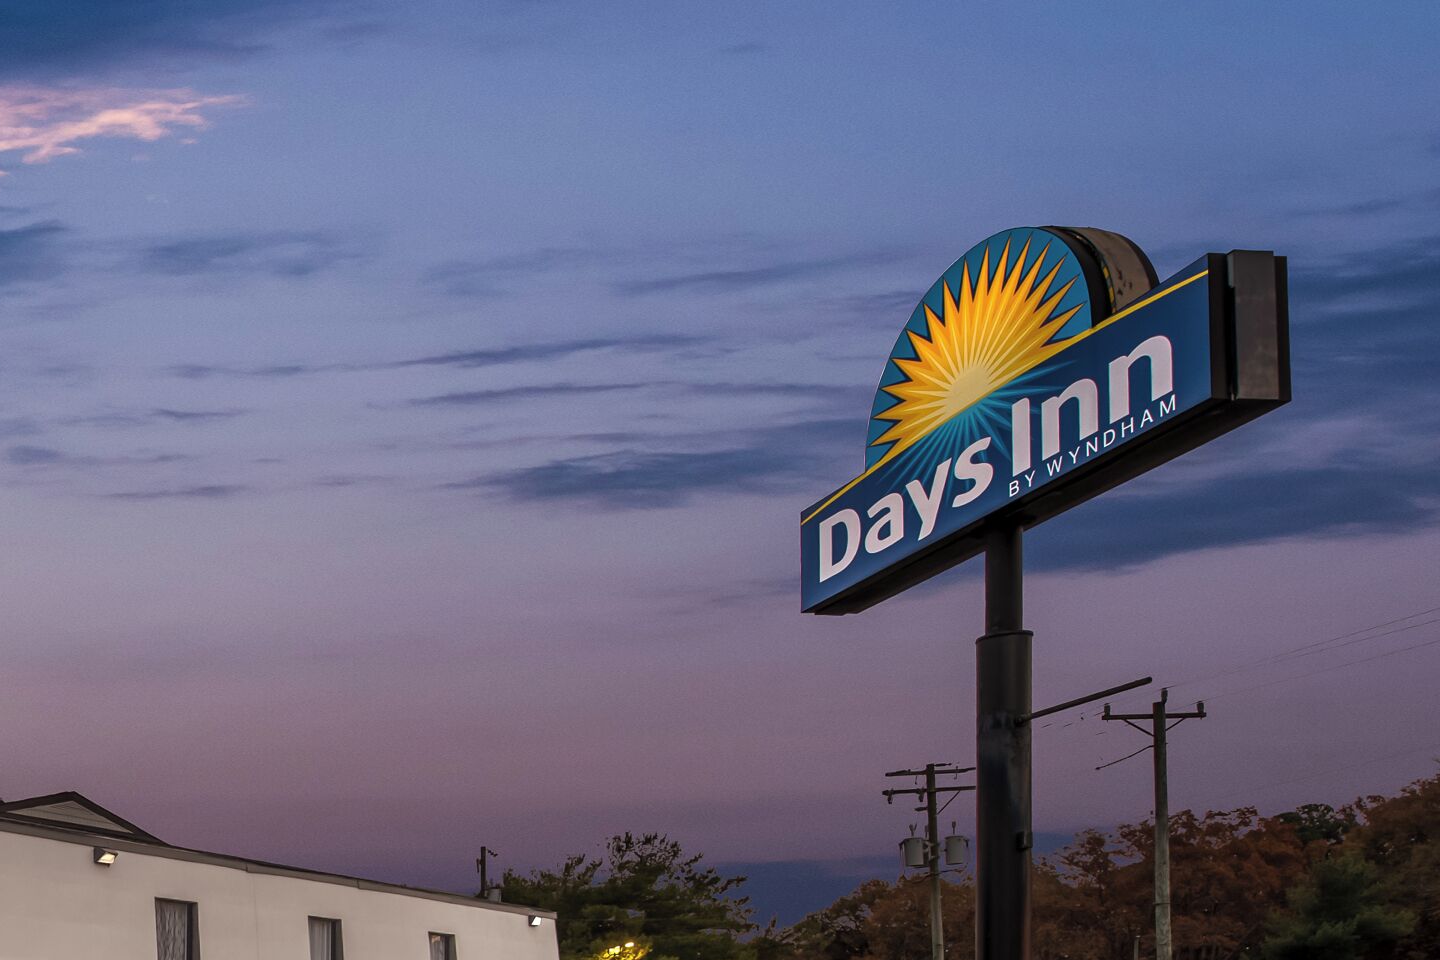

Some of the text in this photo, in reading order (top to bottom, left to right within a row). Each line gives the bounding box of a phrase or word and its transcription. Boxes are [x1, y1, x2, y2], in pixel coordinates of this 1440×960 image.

[819, 335, 1173, 583] Days Inn
[1009, 394, 1176, 497] BY WYNDHAM
